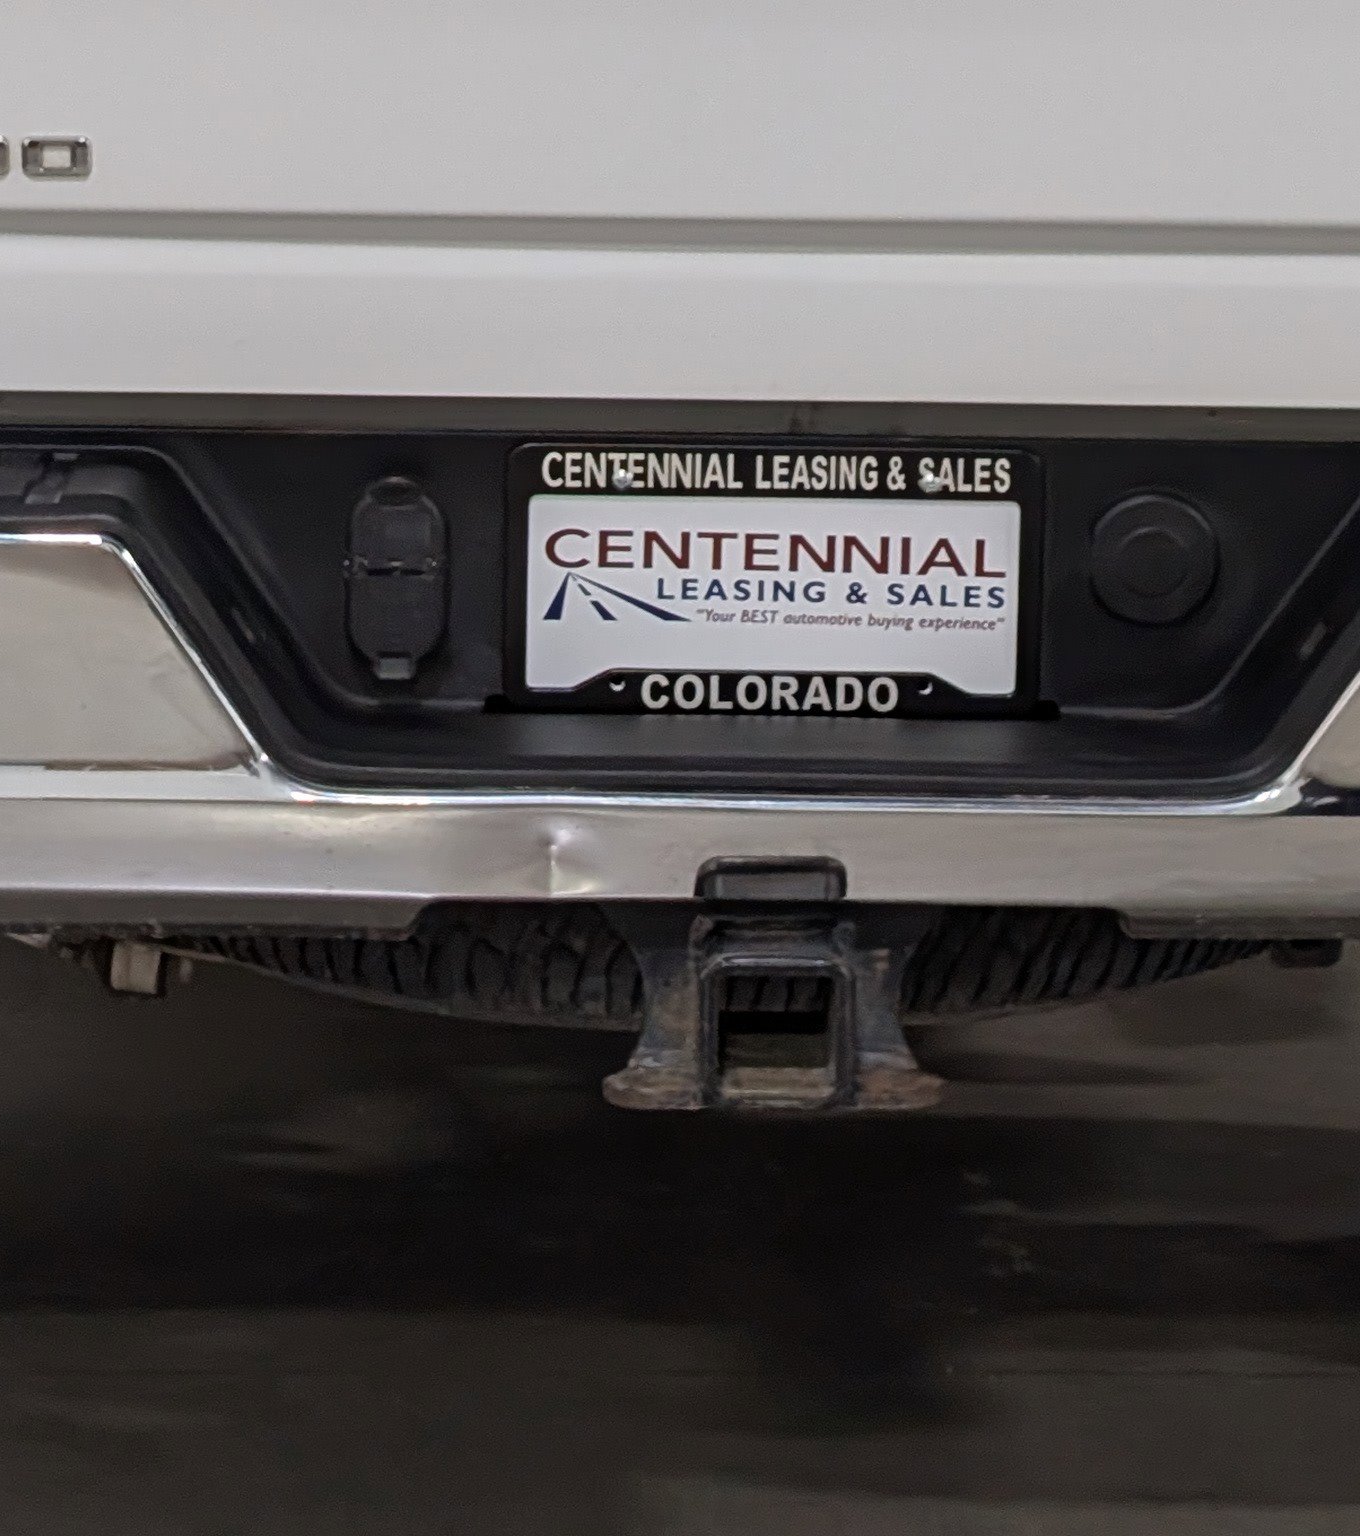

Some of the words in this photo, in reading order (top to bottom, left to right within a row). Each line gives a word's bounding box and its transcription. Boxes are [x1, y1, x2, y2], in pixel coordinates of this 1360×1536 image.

[541, 451, 743, 489] CENTENNIAL
[755, 454, 879, 491] LEASING
[887, 455, 906, 491] &
[918, 457, 1011, 494] SALES
[544, 528, 1006, 578] CENTENNIAL
[657, 577, 826, 603] LEASING
[846, 581, 868, 605] &
[887, 583, 1005, 609] SALES
[740, 609, 779, 624] BEST
[783, 613, 863, 627] automotive
[867, 614, 914, 632] buying
[640, 674, 899, 713] COLORADO
